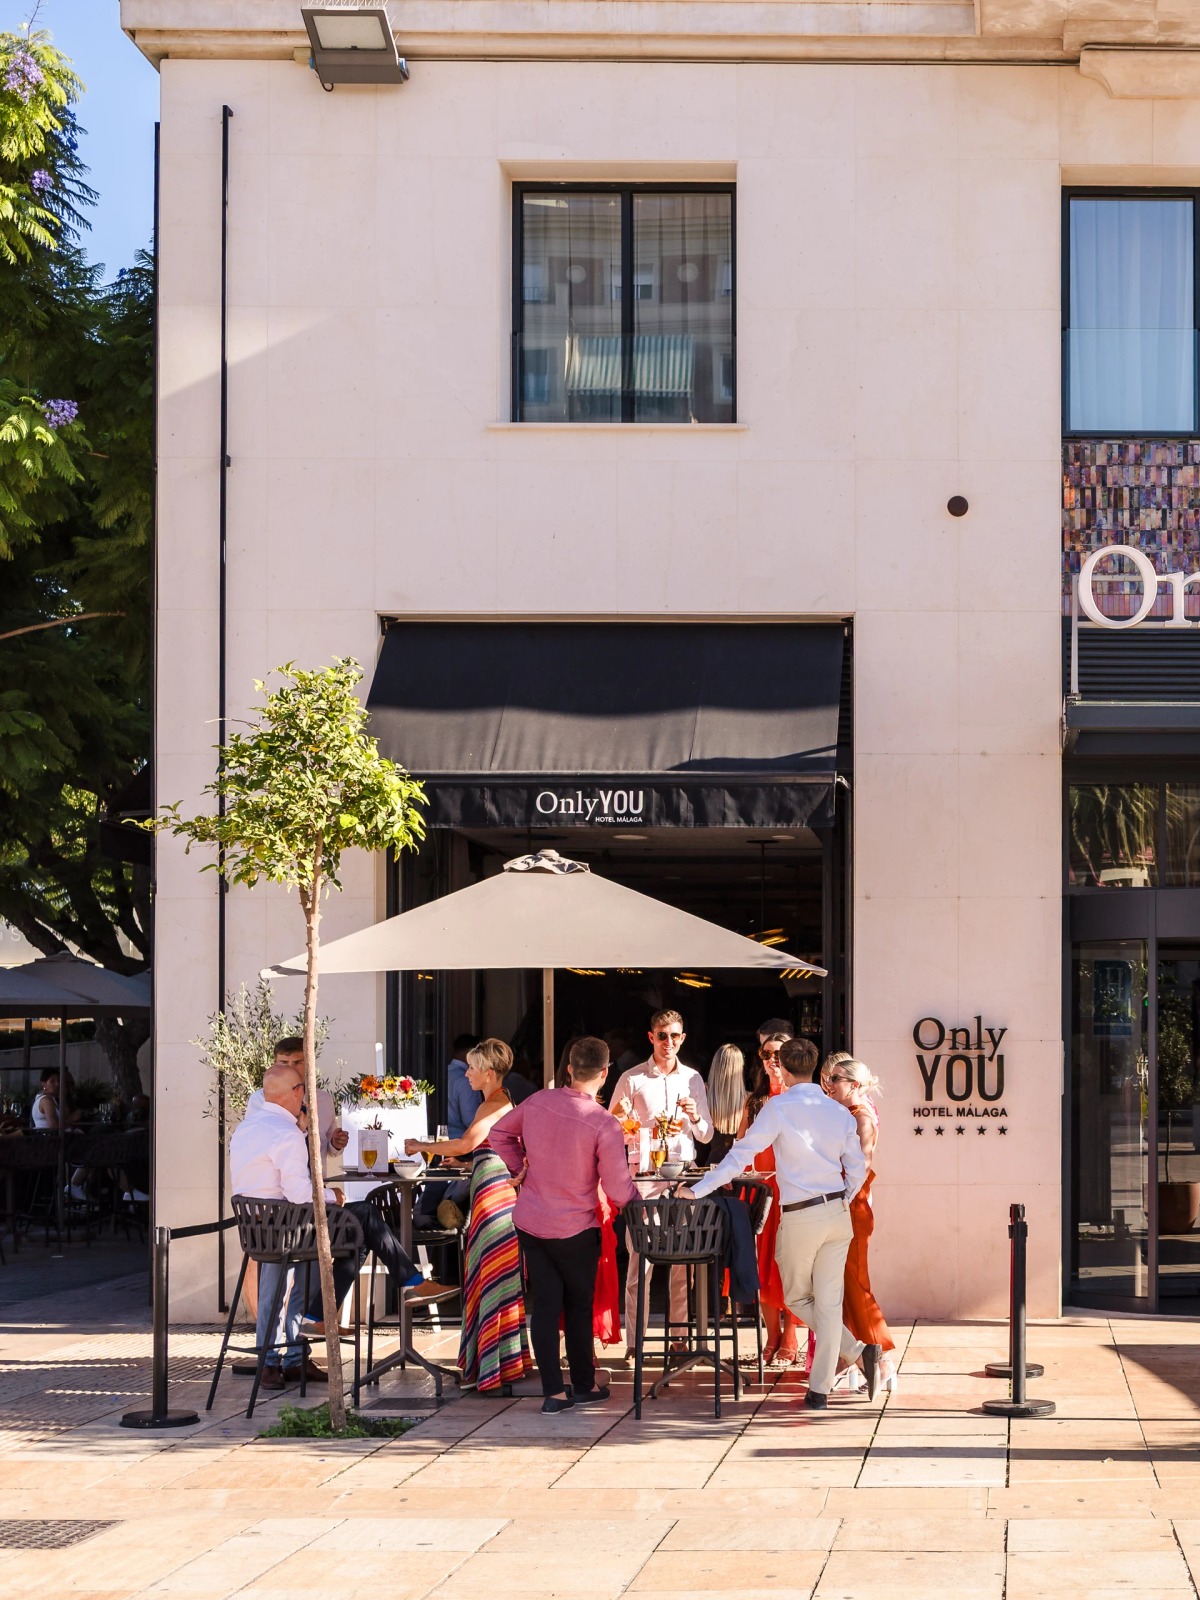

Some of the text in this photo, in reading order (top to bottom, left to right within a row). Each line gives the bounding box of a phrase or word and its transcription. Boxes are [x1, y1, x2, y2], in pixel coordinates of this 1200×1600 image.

[616, 815, 643, 823] MÁLAGA
[912, 1015, 1008, 1062] Only
[916, 1054, 1005, 1102] YOU
[913, 1103, 1008, 1118] HOTEL MÁLAGA
